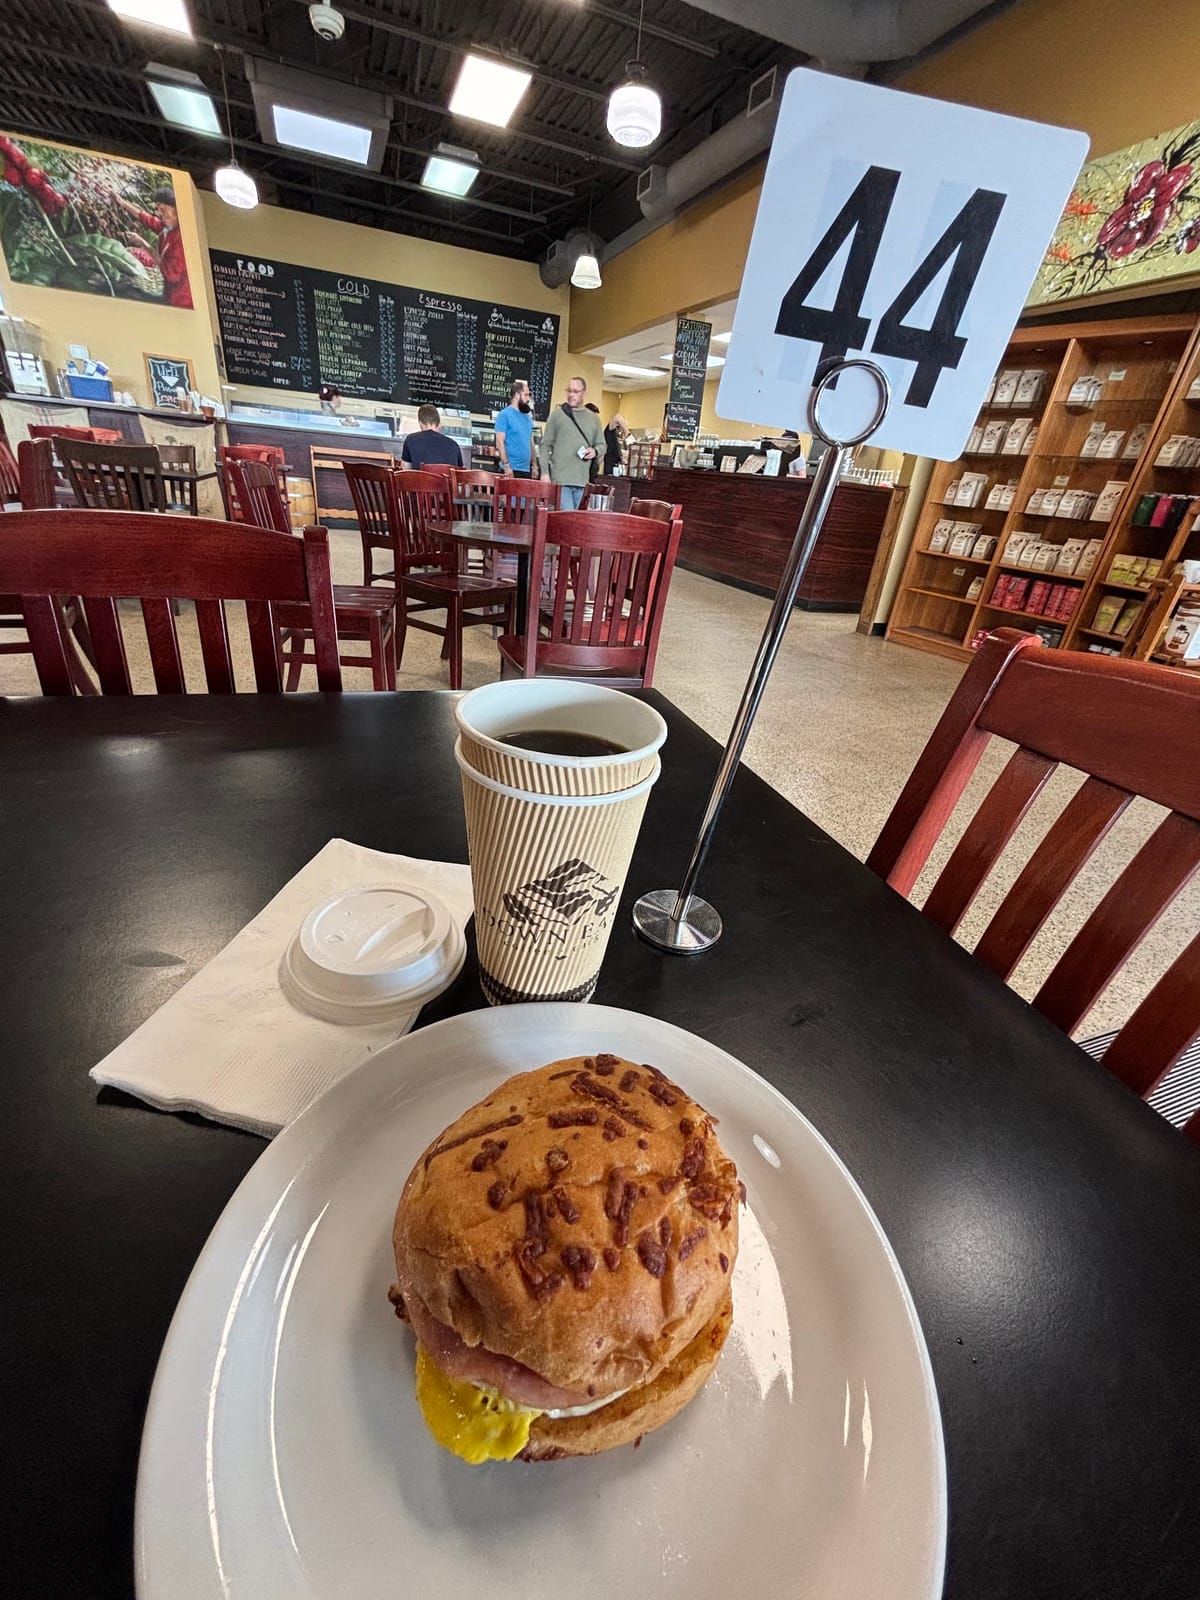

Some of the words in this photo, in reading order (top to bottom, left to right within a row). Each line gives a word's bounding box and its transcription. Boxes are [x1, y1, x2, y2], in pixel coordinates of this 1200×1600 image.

[237, 260, 275, 277] FOOD
[337, 279, 370, 297] COLD
[774, 165, 1007, 408] 44
[419, 293, 462, 312] Espresso
[482, 906, 569, 945] DOWN
